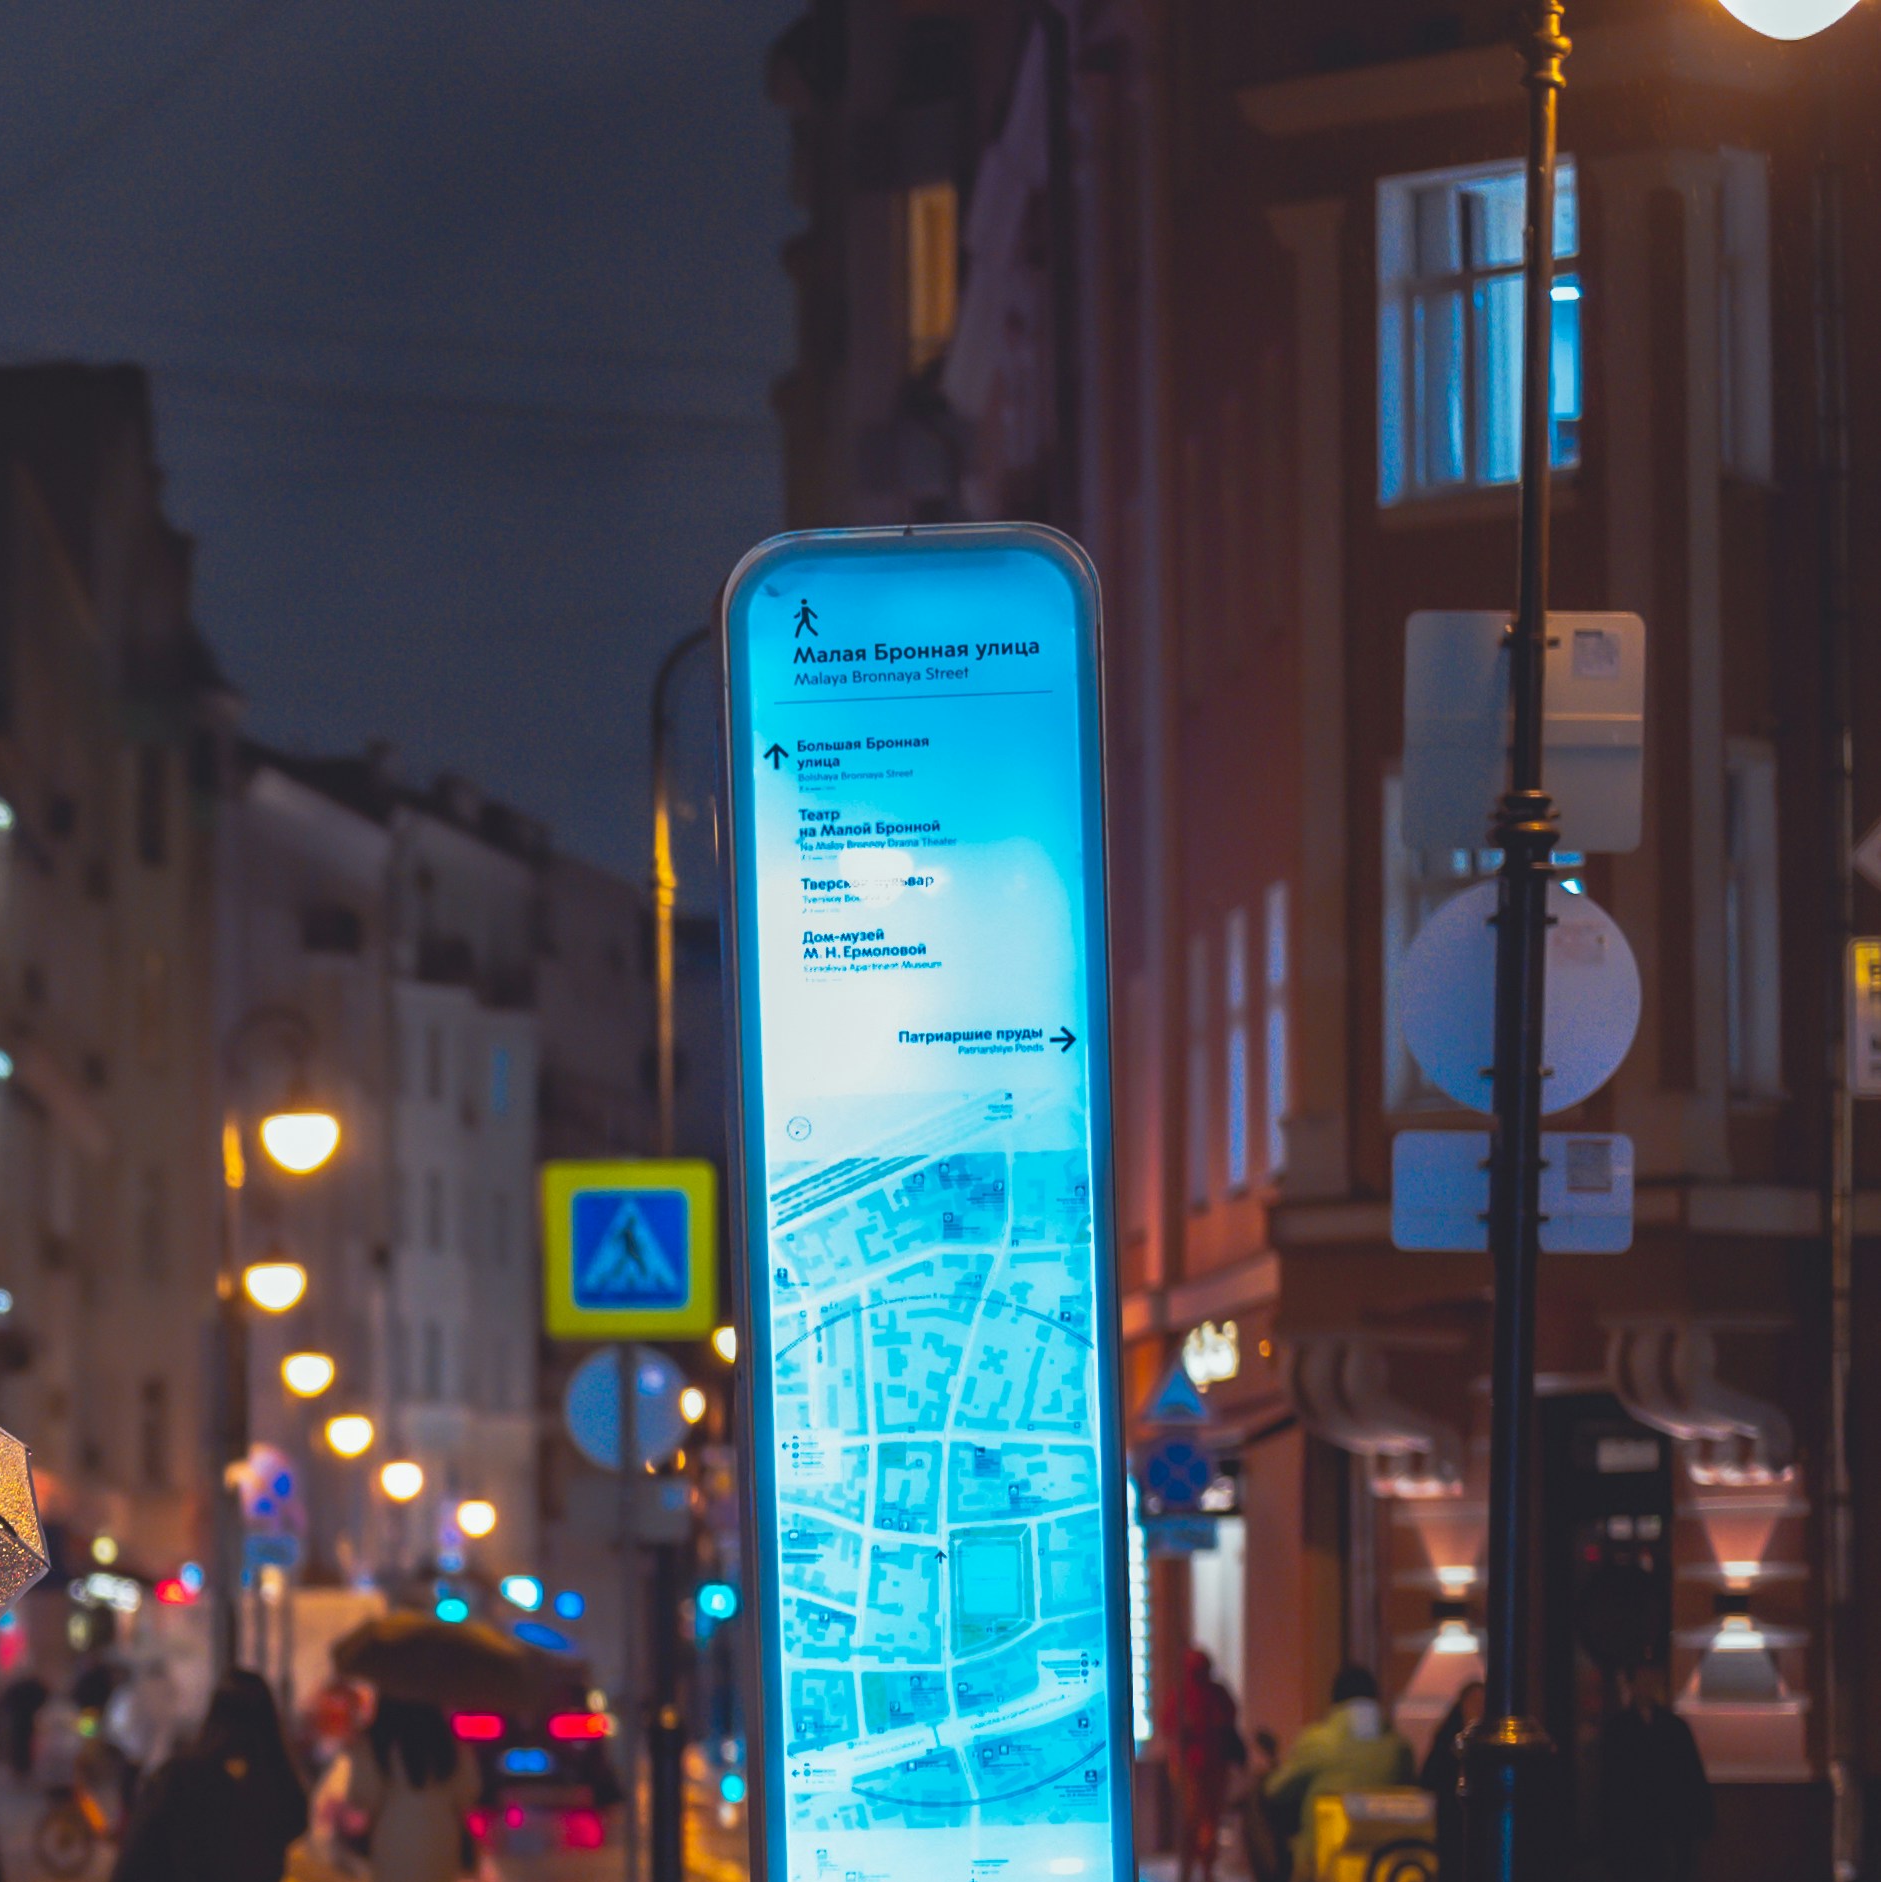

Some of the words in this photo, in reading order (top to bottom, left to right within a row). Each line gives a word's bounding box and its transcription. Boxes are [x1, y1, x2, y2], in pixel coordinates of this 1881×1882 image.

[793, 647, 866, 664] Малая
[874, 643, 969, 664] Бронная
[975, 641, 1040, 661] улица
[794, 671, 847, 687] Malaya
[852, 668, 921, 684] Bronnaya
[926, 667, 969, 680] Street
[797, 739, 861, 752] Большая
[866, 736, 930, 751] Бронная
[797, 756, 840, 770] улица
[798, 773, 838, 782] Bolshaya
[841, 771, 884, 780] Bronnaya
[886, 769, 913, 777] Street
[798, 809, 840, 823] Театр
[799, 826, 816, 838] на
[820, 822, 871, 836] Малой
[876, 820, 941, 837] Бронной
[887, 838, 919, 848] Drama
[921, 837, 957, 847] Theater
[802, 928, 885, 945] Дом-музей
[825, 946, 841, 959] Н.
[844, 942, 927, 960] Ермоловой
[898, 1030, 992, 1045] Патриаршие
[996, 1028, 1043, 1041] пруды
